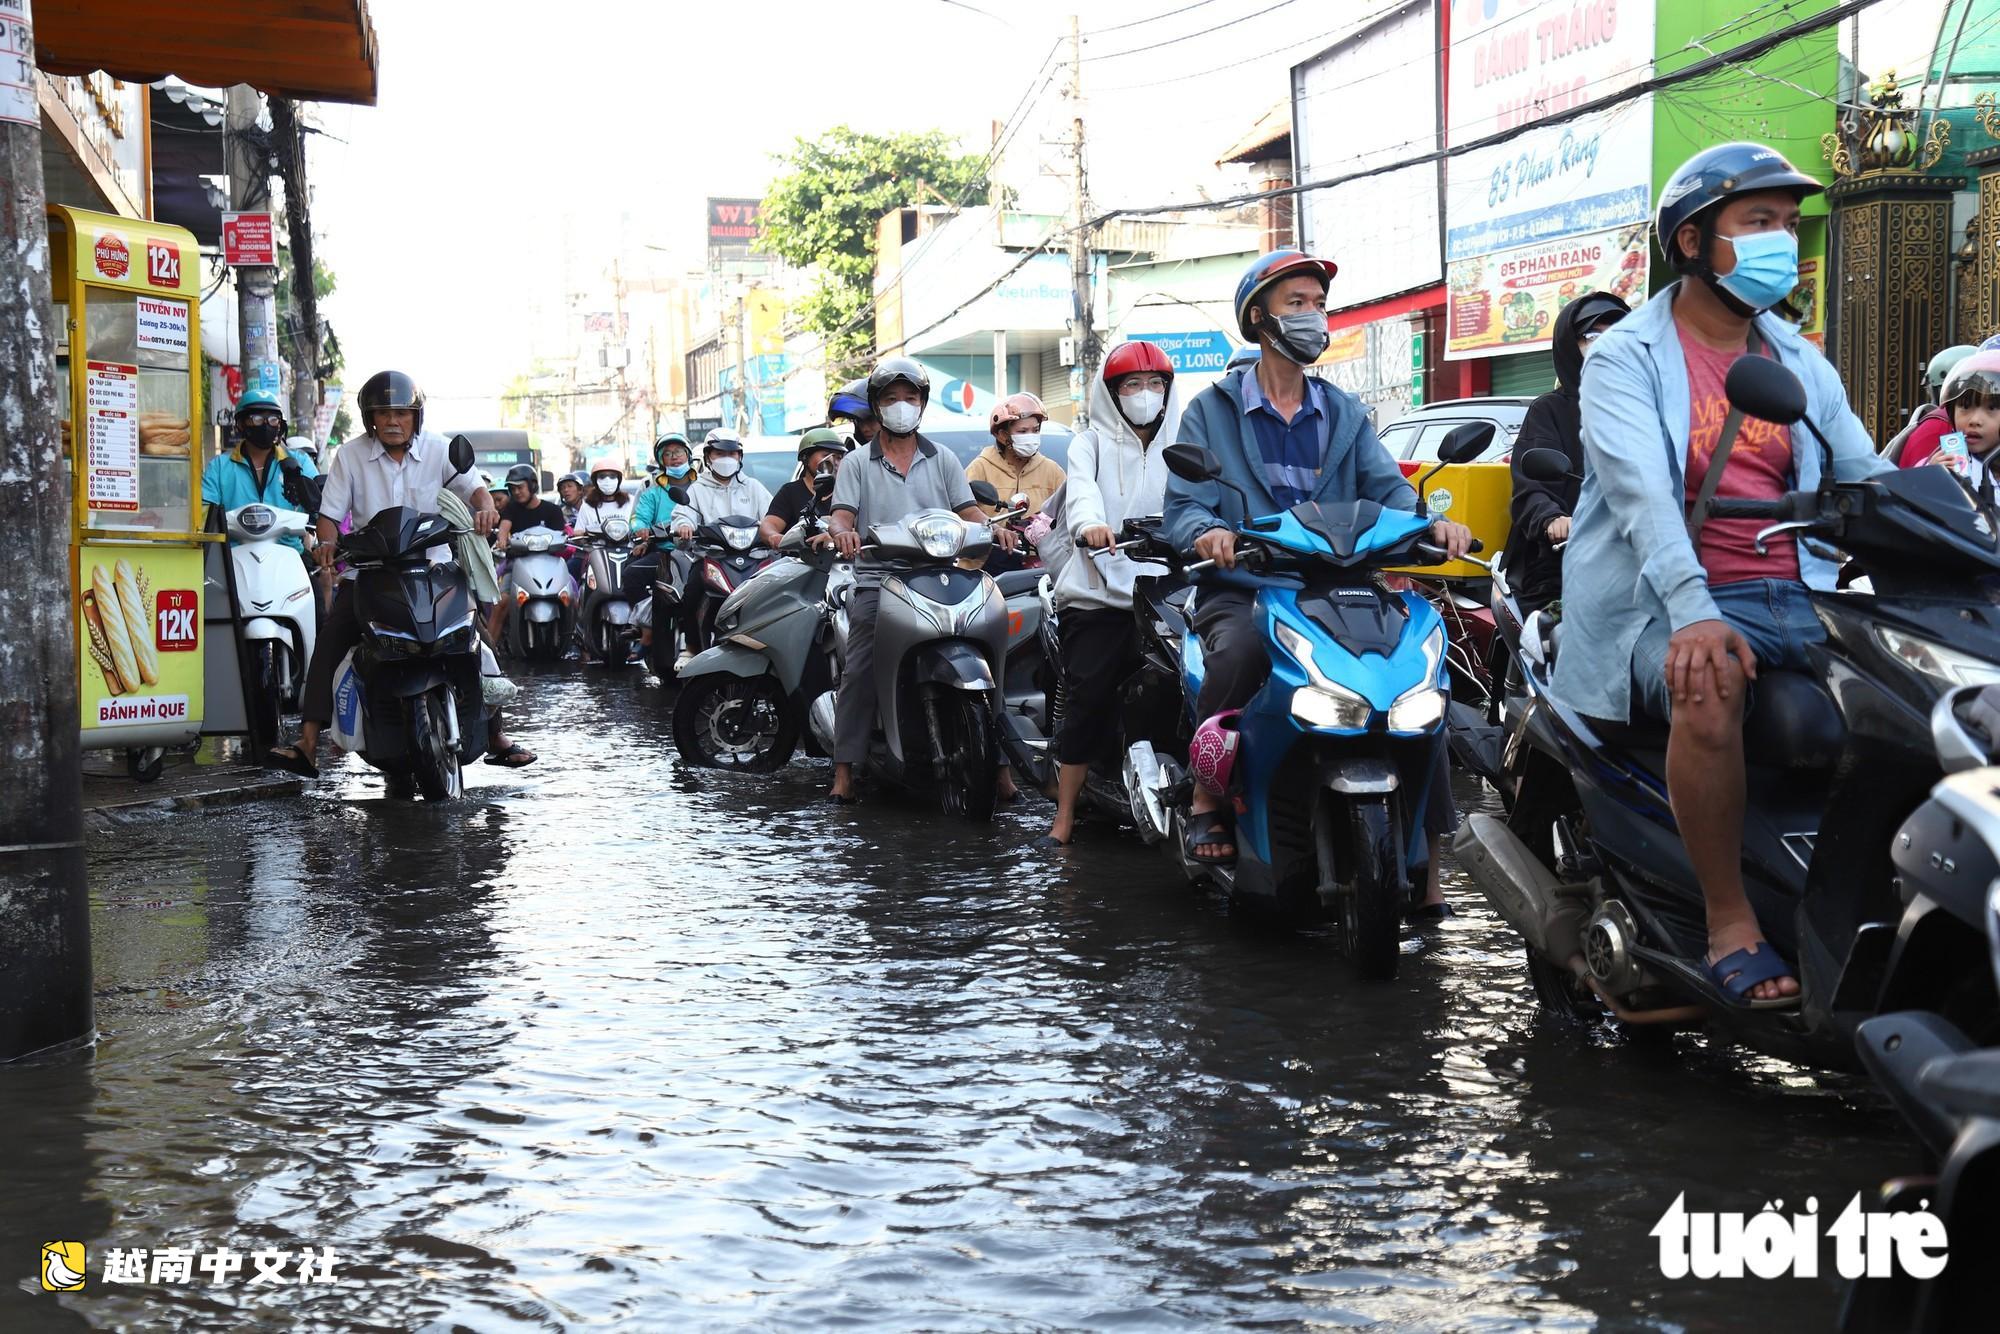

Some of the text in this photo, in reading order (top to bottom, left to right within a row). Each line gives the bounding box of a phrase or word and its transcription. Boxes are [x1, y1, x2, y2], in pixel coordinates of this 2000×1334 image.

[1488, 160, 1512, 208] 85
[96, 247, 128, 262] PHÚ HƯNG
[149, 245, 179, 279] 12K
[1501, 246, 1601, 277] 85 PHAN RANG
[997, 284, 1070, 299] VietinBan
[139, 301, 187, 318] TUYỂN NV
[1186, 338, 1211, 348] THPT
[1185, 353, 1224, 368] LONG
[170, 594, 182, 607] TỪ
[159, 609, 195, 640] 12K
[100, 698, 185, 720] BÁNH MÌ QUE
